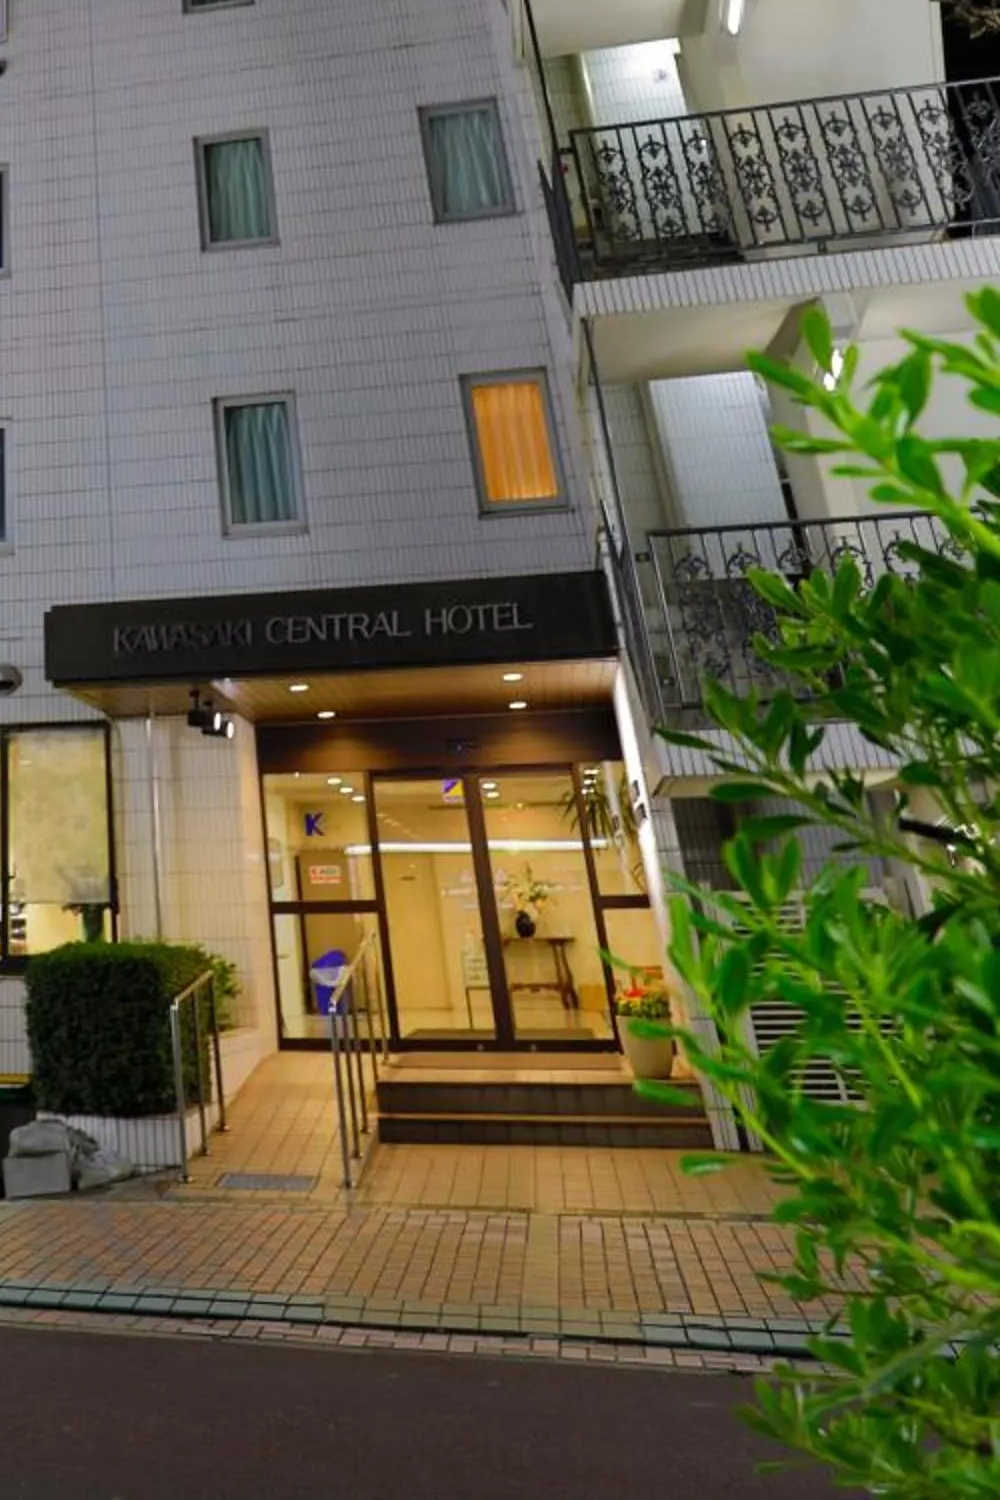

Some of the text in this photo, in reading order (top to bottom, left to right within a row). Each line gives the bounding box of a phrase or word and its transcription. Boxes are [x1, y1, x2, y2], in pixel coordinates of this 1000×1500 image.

[114, 602, 533, 653] KAWASAKI CENTRAL HOTEL
[305, 812, 325, 836] K
